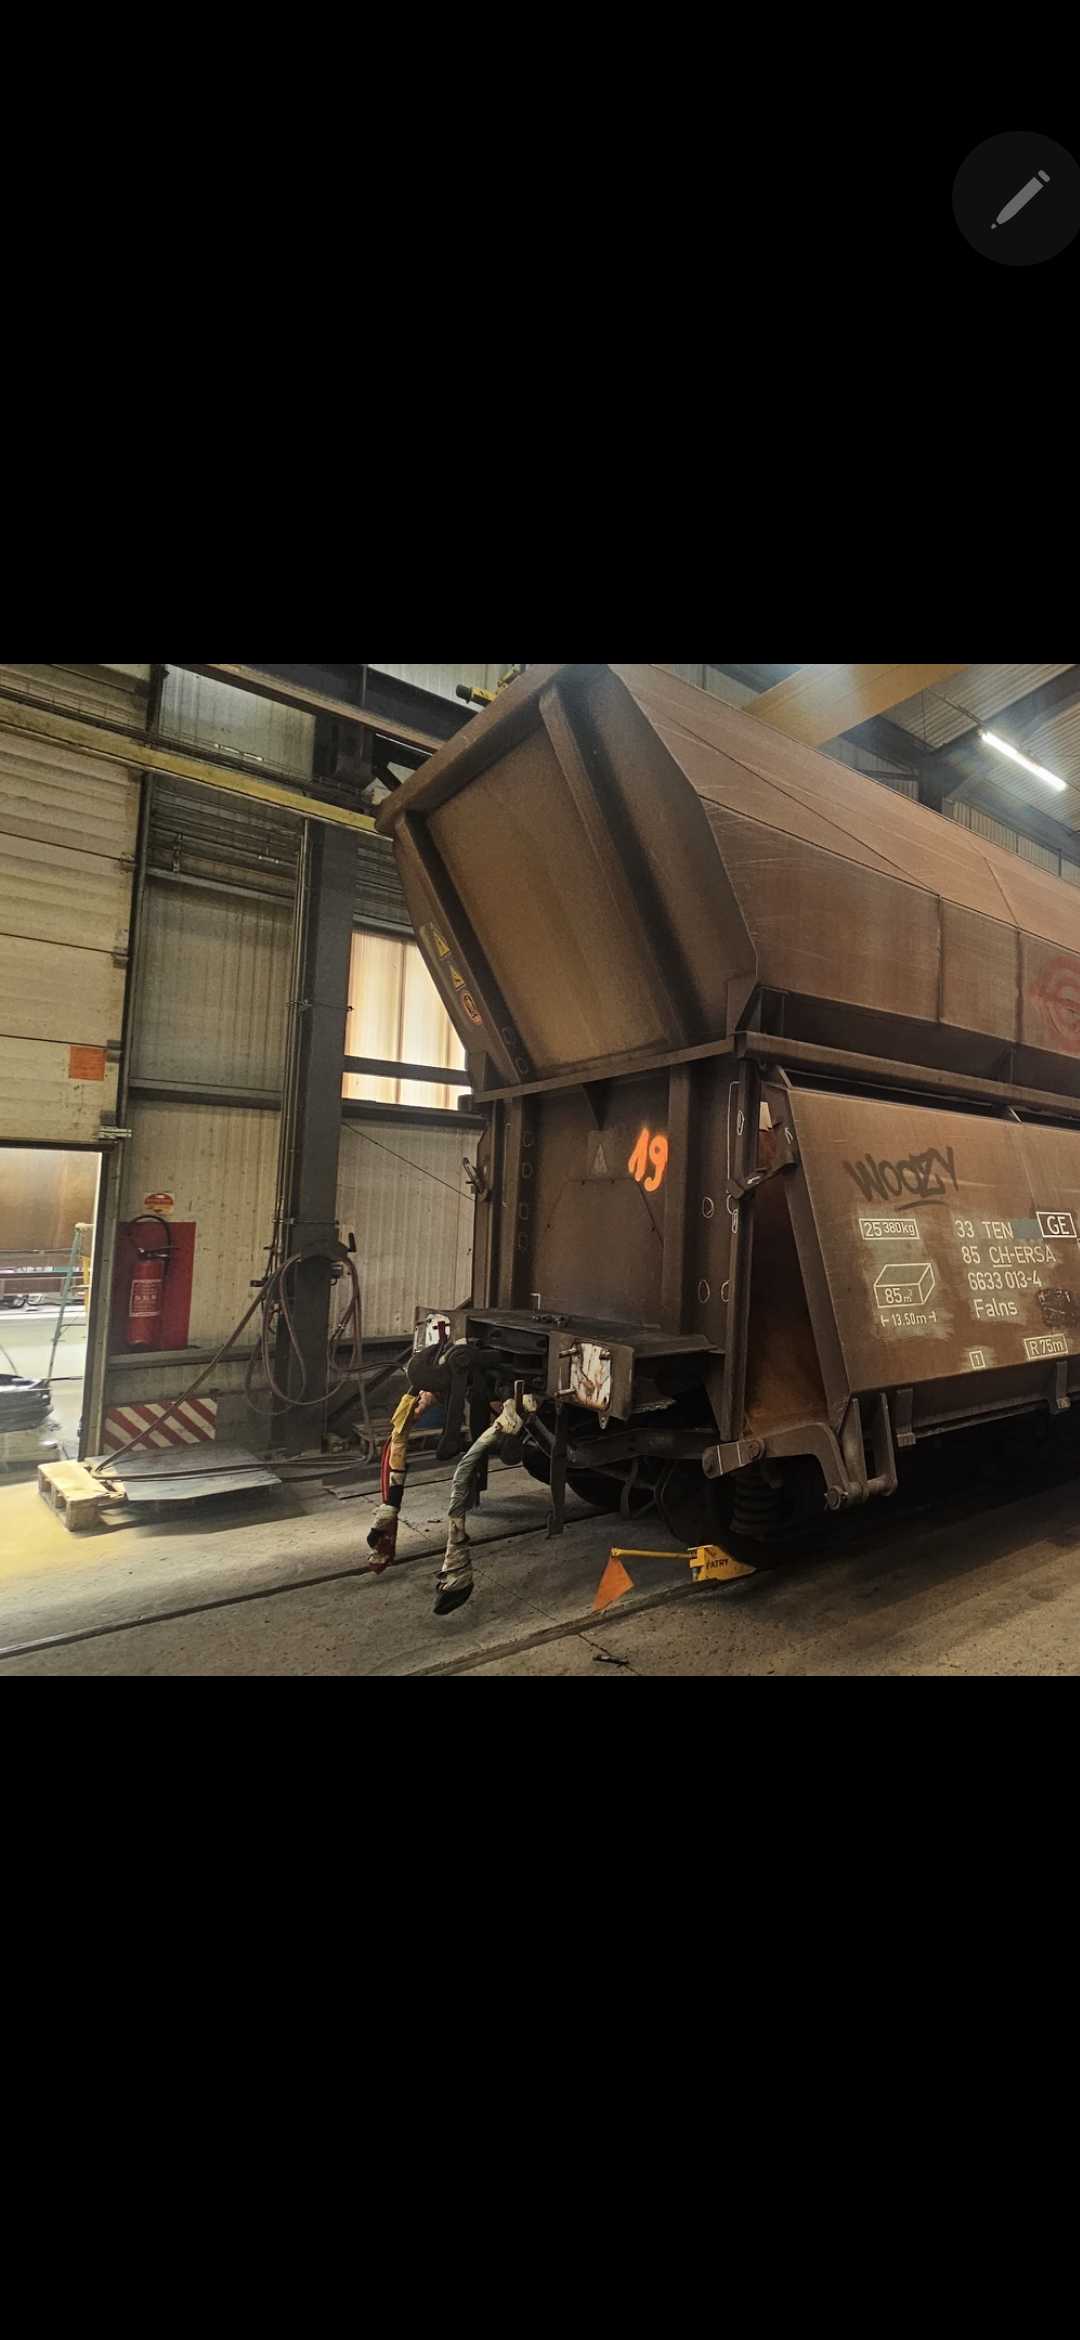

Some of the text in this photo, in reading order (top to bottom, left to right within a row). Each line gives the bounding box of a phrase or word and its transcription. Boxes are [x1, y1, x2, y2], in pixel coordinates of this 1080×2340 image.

[627, 1126, 669, 1192] 19
[954, 1219, 1014, 1239] 33 TEN
[1046, 1215, 1070, 1235] GE
[961, 1245, 1057, 1265] 85 CH-ERSA
[967, 1269, 1042, 1291] 6633 013-4
[973, 1297, 1018, 1319] Falns
[891, 1312, 927, 1327] 13.50m
[706, 1558, 729, 1571] PATRY
